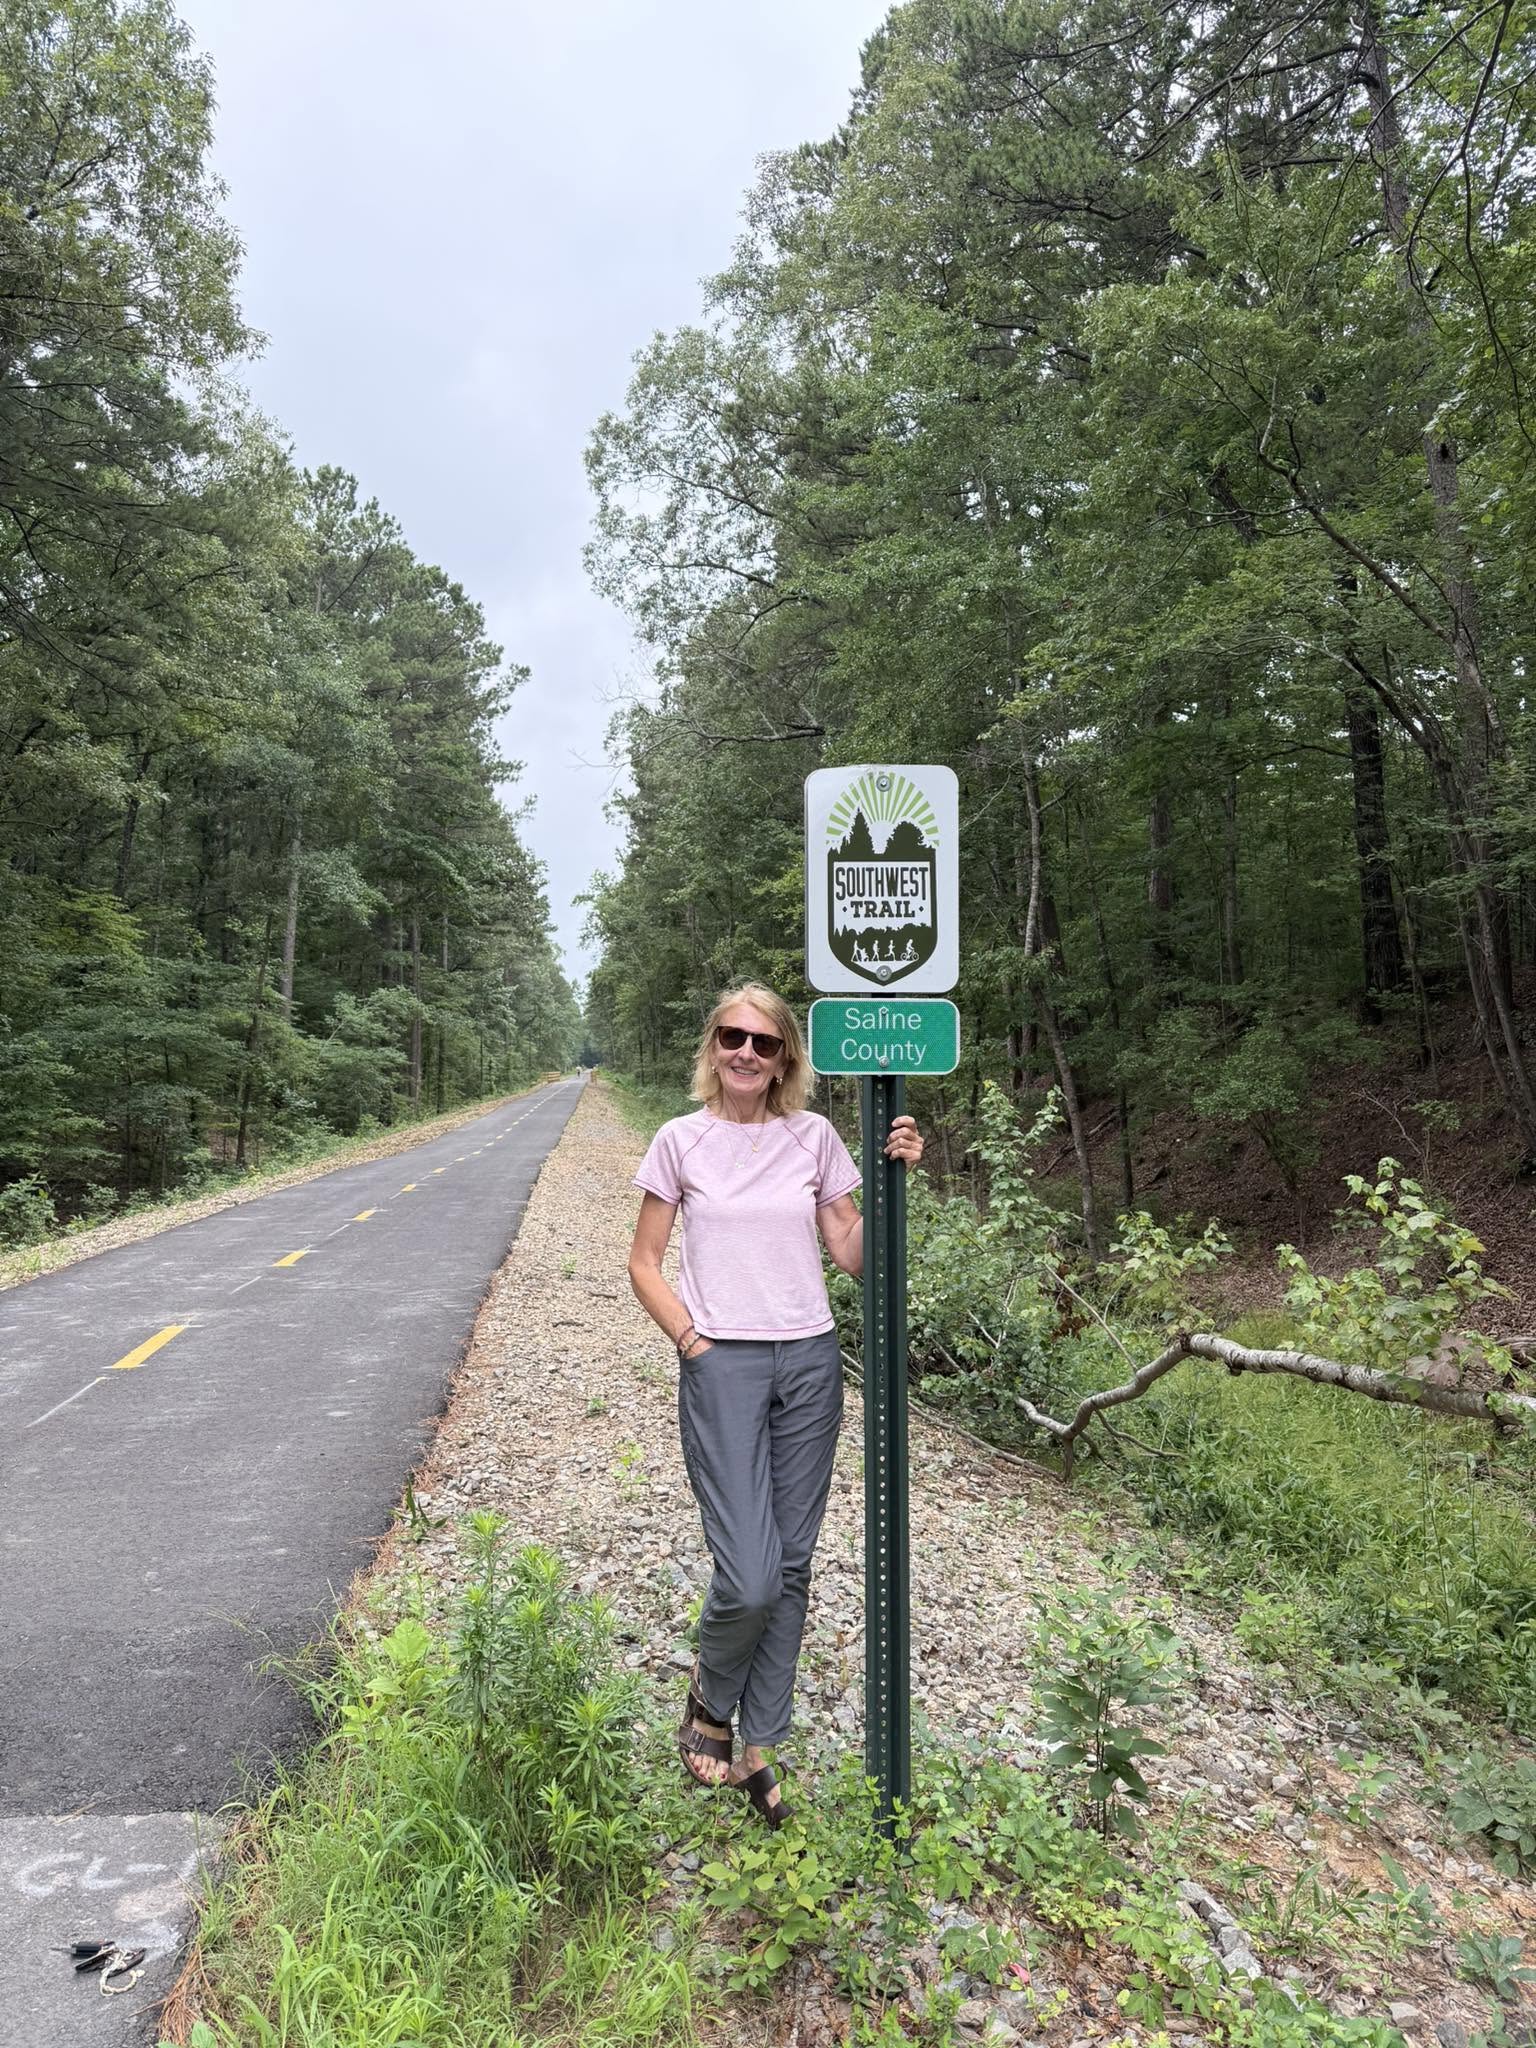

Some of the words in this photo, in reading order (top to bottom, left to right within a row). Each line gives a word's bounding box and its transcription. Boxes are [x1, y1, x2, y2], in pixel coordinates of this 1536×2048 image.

[835, 867, 928, 900] SOUTHWEST
[850, 900, 915, 918] TRAIL
[844, 1006, 922, 1030] Saline
[840, 1038, 927, 1066] County
